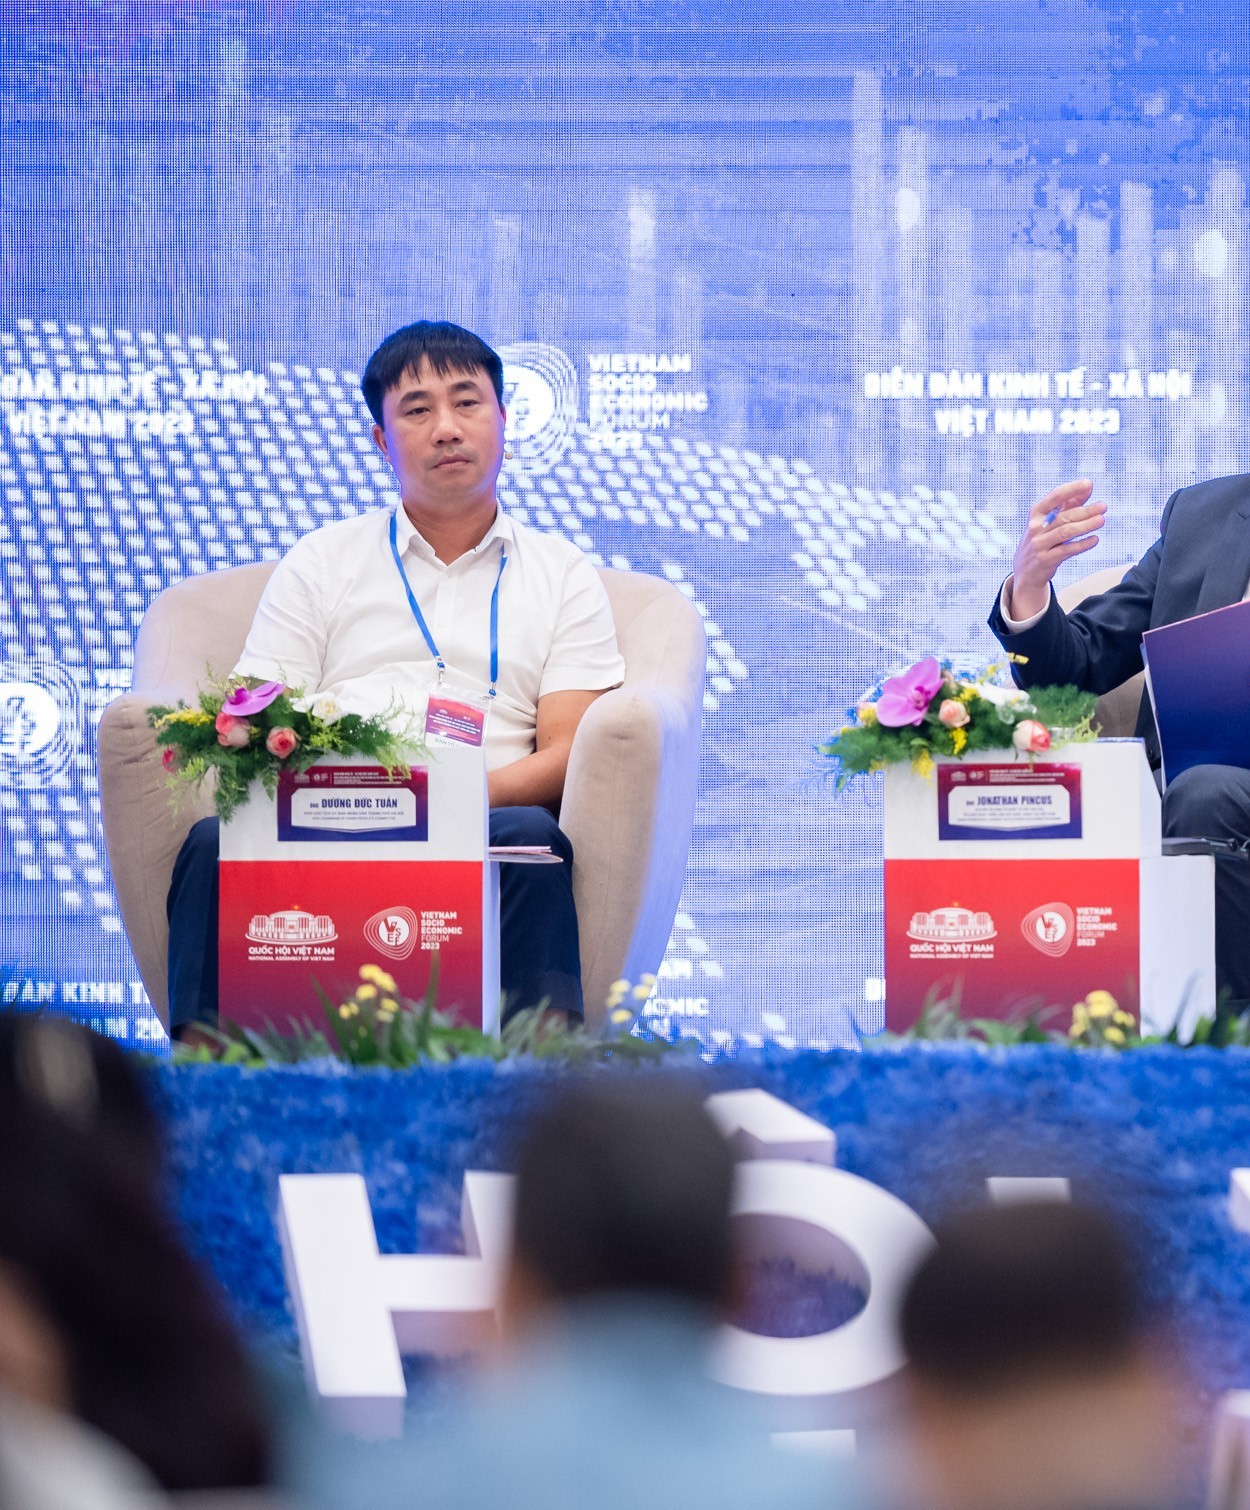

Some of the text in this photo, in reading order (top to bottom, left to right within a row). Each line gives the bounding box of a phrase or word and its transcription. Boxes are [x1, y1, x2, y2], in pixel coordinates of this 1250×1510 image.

[589, 353, 691, 372] VIETNAM
[589, 374, 656, 391] SOCIO
[988, 372, 1049, 399] KINH
[1056, 366, 1087, 399] TẾ
[1109, 368, 1142, 399] XÃ
[1148, 368, 1191, 401] HỘI
[589, 392, 708, 411] ECONOMIC
[589, 413, 670, 428] FORUM
[935, 403, 1120, 438] VIỆT NAM 2023
[588, 431, 643, 450] 2023
[321, 797, 351, 809] DƯƠNG
[354, 797, 372, 809] ĐỨC
[375, 796, 398, 809] TUẤN
[977, 795, 1018, 806] JONATHAN
[1021, 795, 1053, 806] PINCUS
[421, 911, 457, 919] VIETNAM
[1076, 907, 1112, 915] VIETNAM
[1077, 923, 1118, 931] ECONOMIC
[248, 944, 335, 956] QUỐC HỘI VIỆT NAM
[421, 942, 440, 950] 2023
[909, 942, 994, 953] QUỐC HỘI VIỆT NAM
[62, 981, 124, 1002] KINH
